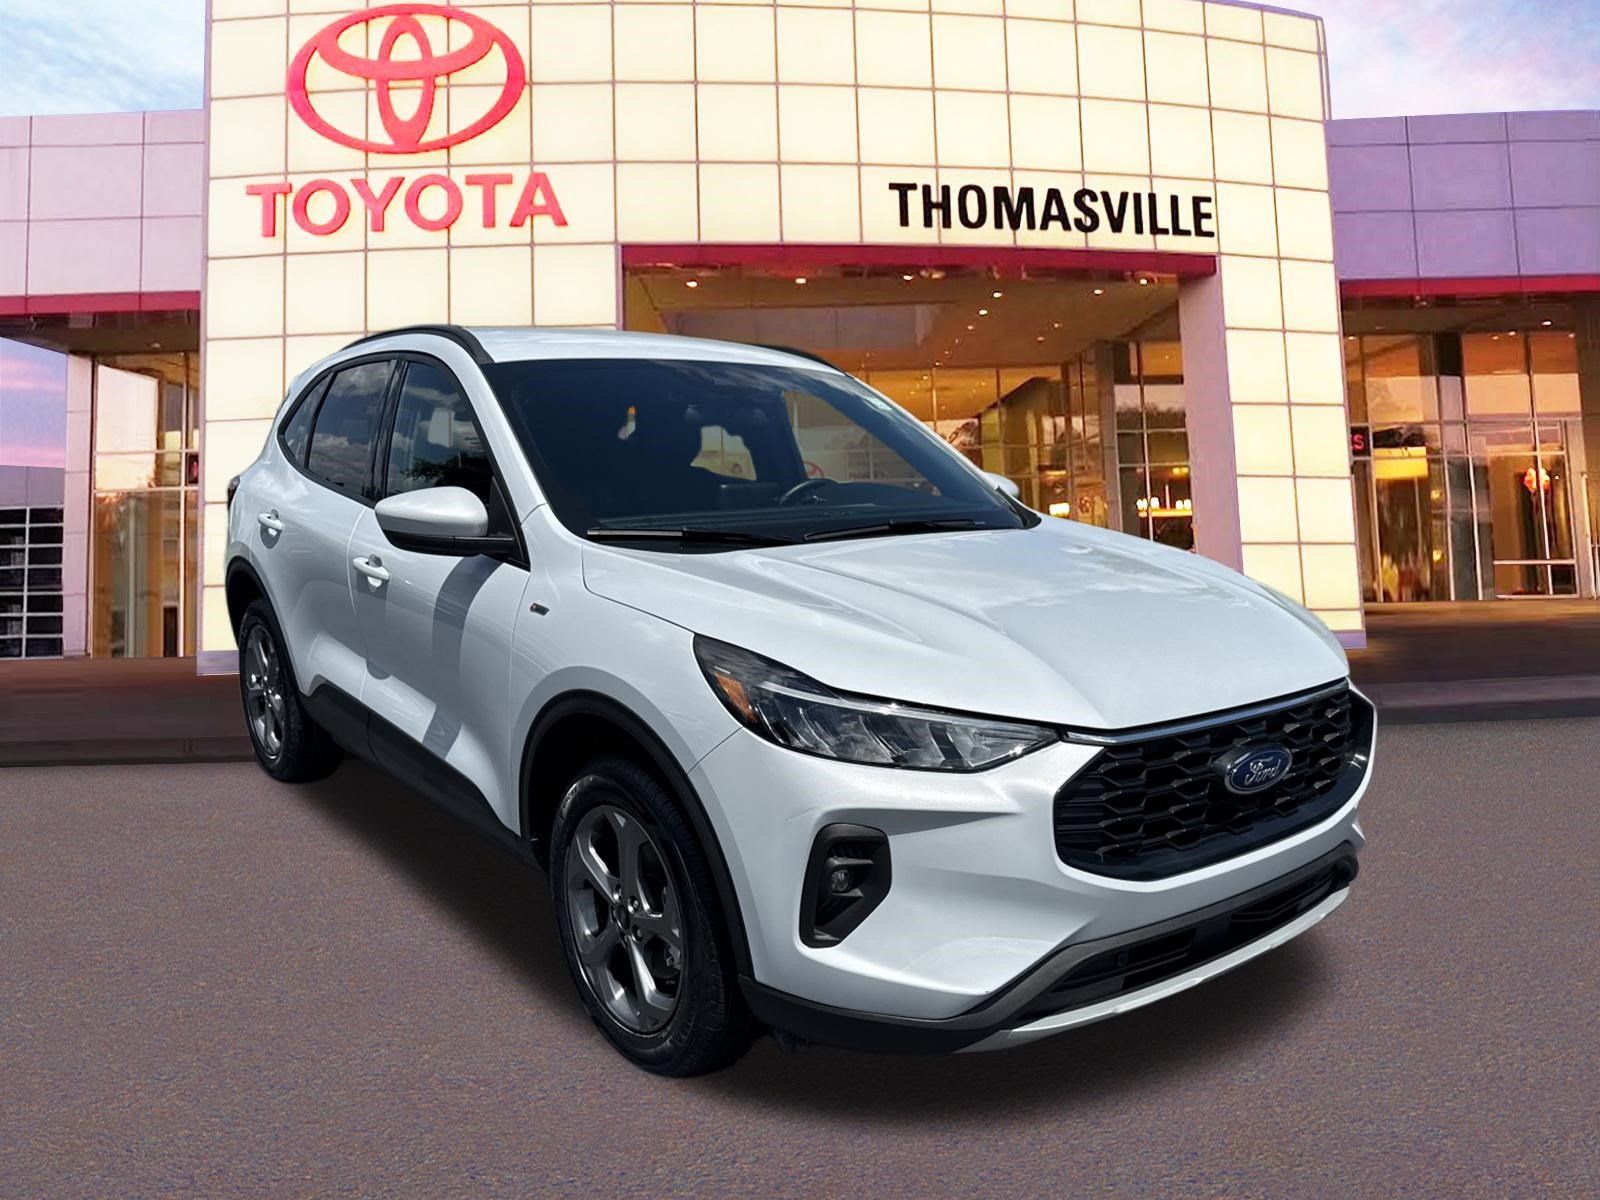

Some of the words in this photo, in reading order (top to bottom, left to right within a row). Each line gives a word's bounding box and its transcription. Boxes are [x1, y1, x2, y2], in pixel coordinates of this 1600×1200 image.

[246, 172, 569, 238] TOYOTA
[888, 182, 1215, 238] THOMASVILLE
[1244, 756, 1281, 785] Ford
